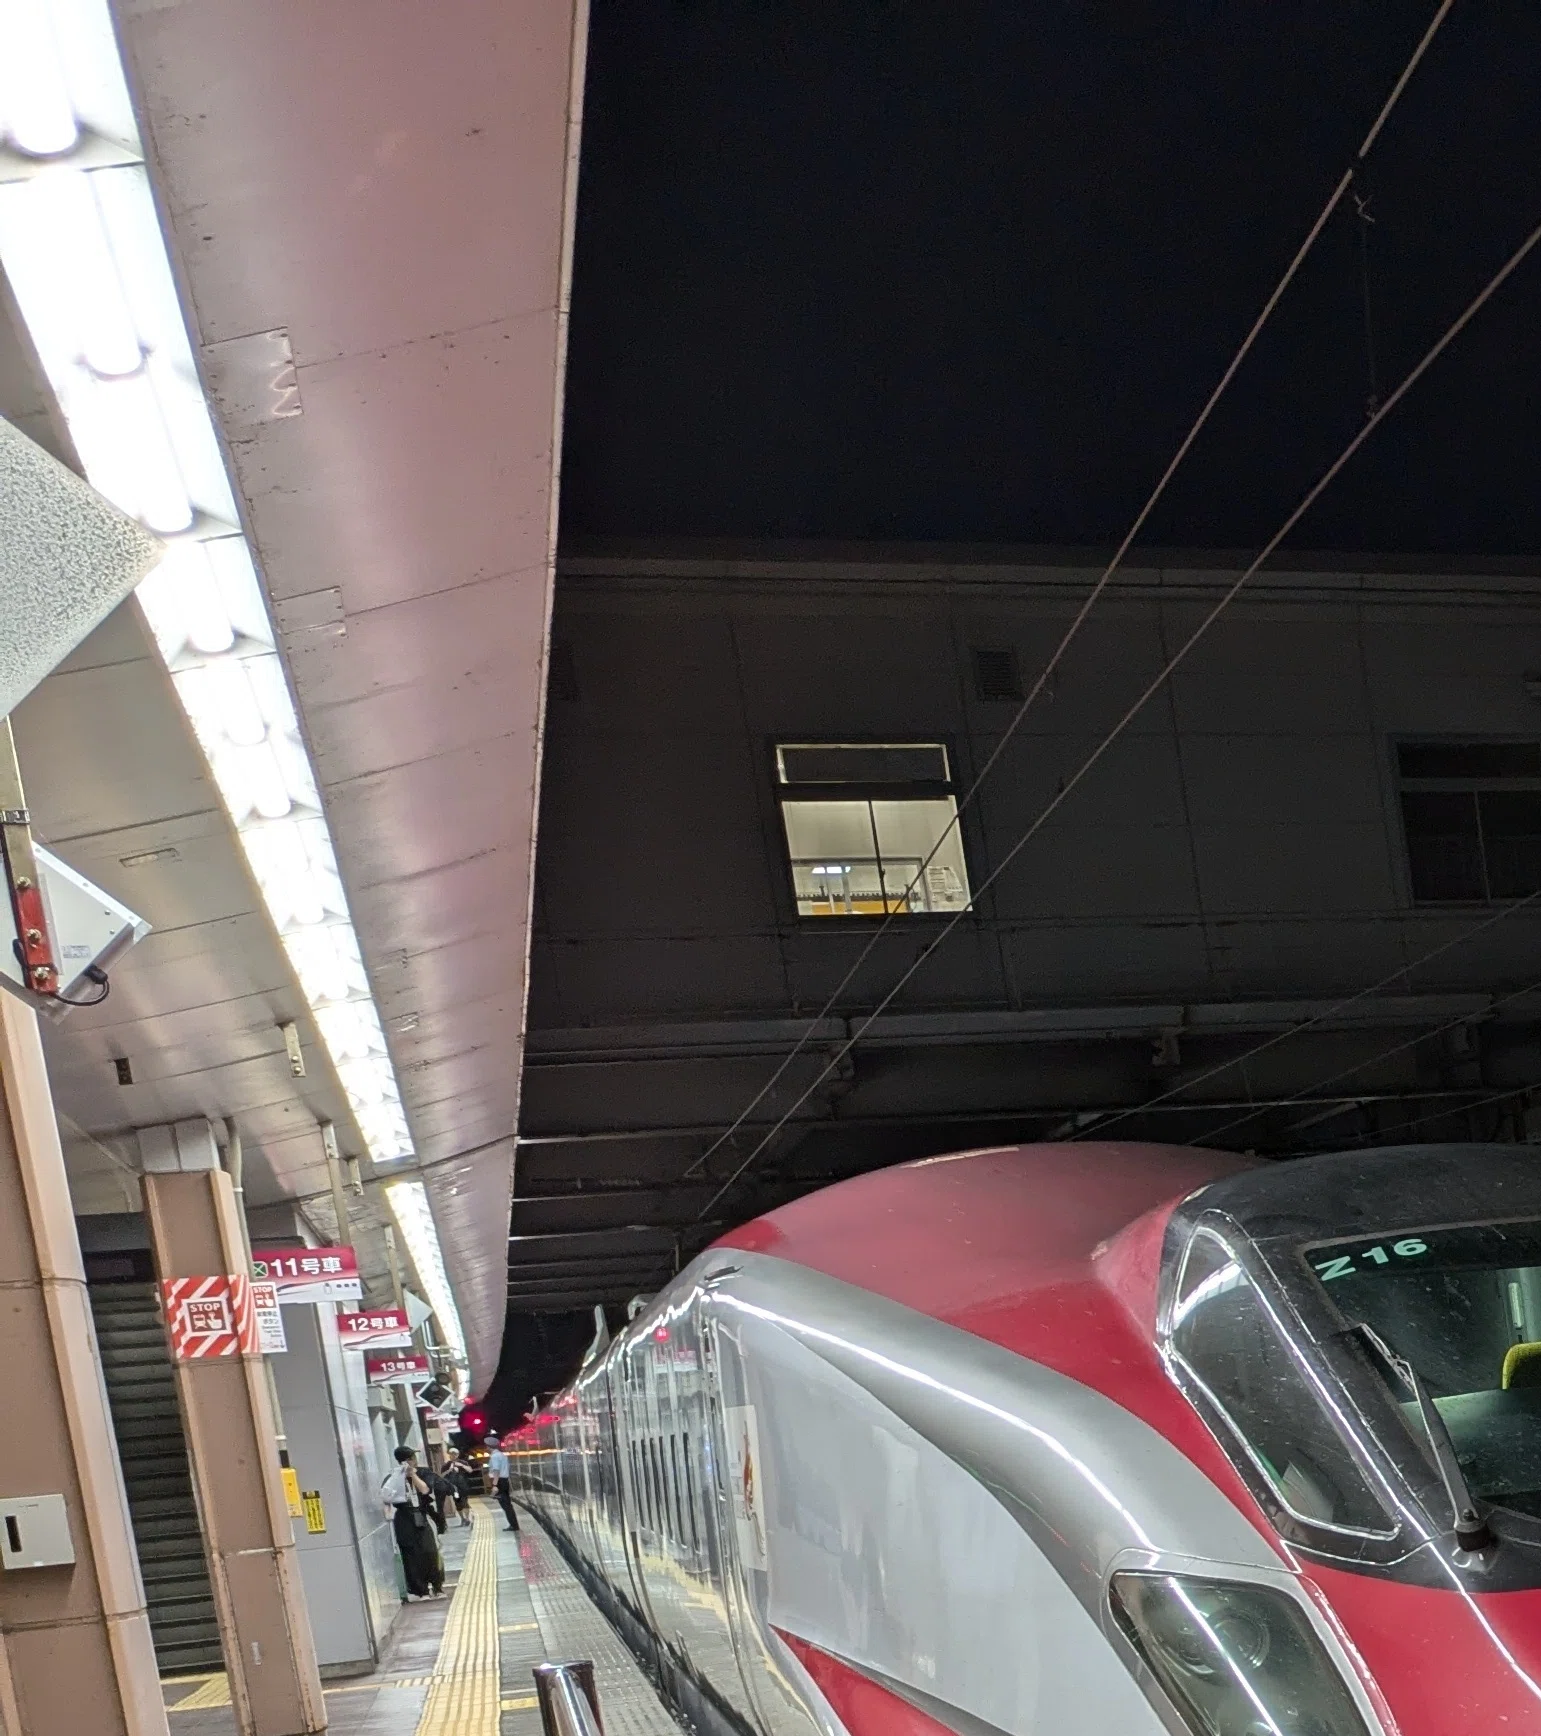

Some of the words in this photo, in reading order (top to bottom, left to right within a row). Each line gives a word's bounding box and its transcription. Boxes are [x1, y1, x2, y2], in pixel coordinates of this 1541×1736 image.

[270, 1256, 343, 1278] 11号車
[189, 1302, 221, 1313] STOP
[347, 1316, 399, 1332] 12号車
[380, 1360, 417, 1373] 13号車
